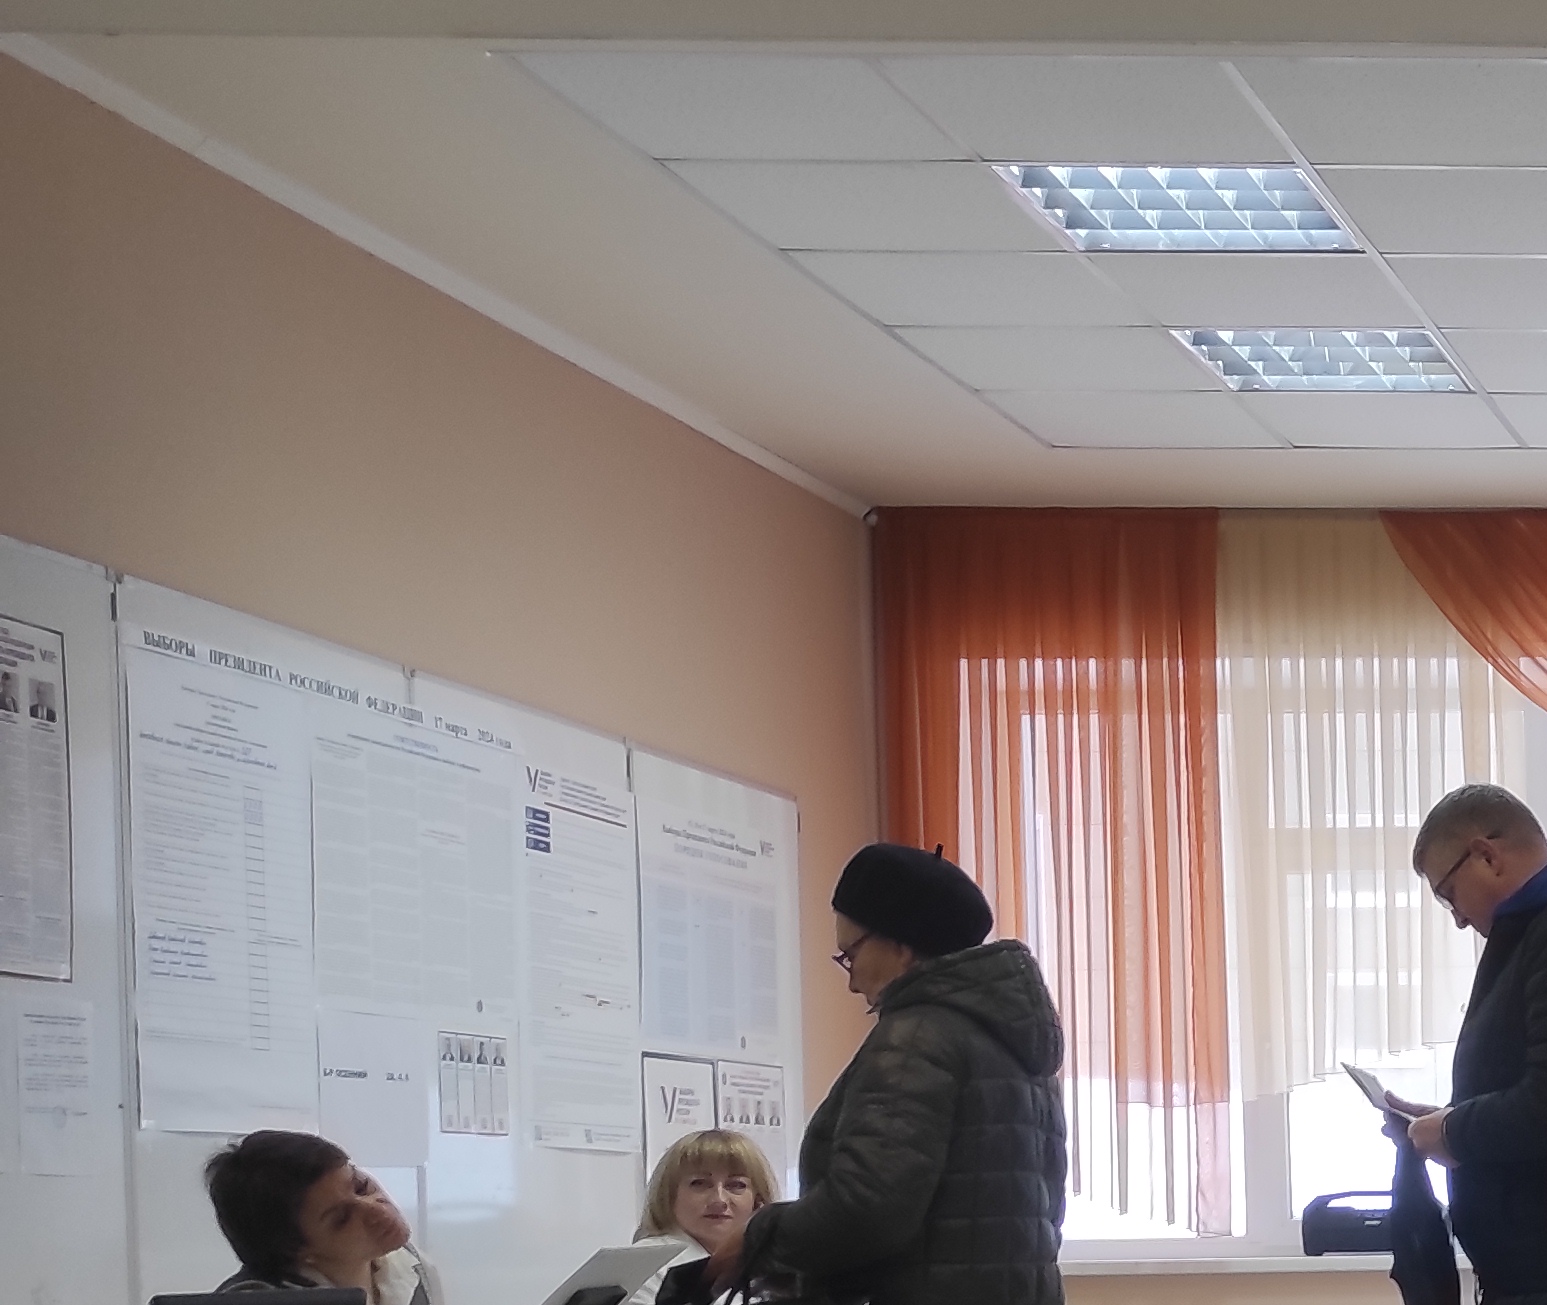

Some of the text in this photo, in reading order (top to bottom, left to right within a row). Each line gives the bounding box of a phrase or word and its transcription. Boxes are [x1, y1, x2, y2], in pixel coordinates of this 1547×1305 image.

[143, 630, 196, 658] ВЫБОРЫ
[208, 649, 281, 681] ПРЕЗИДЕНТА
[288, 672, 359, 705] РОССИЙСКОЙ
